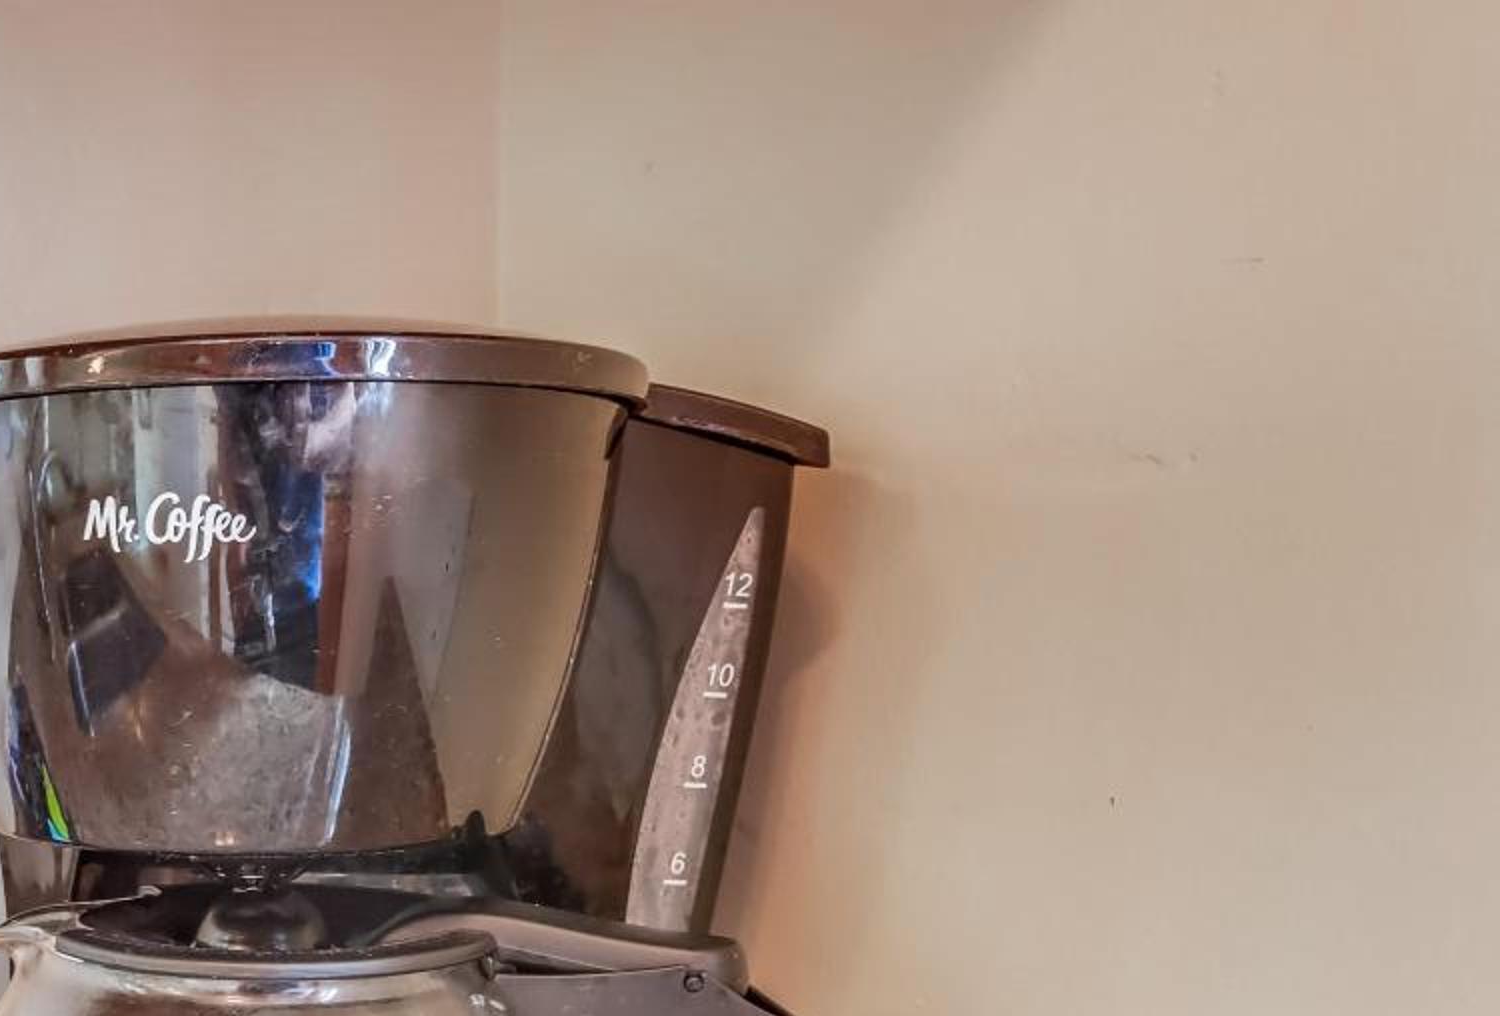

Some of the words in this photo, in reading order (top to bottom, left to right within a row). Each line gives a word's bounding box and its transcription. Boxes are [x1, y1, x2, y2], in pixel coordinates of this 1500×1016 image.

[83, 495, 140, 553] Mr.
[145, 491, 257, 563] Coffee
[724, 573, 753, 598] 12
[706, 663, 735, 688] 10
[690, 755, 707, 778] 8
[670, 852, 686, 875] 6
